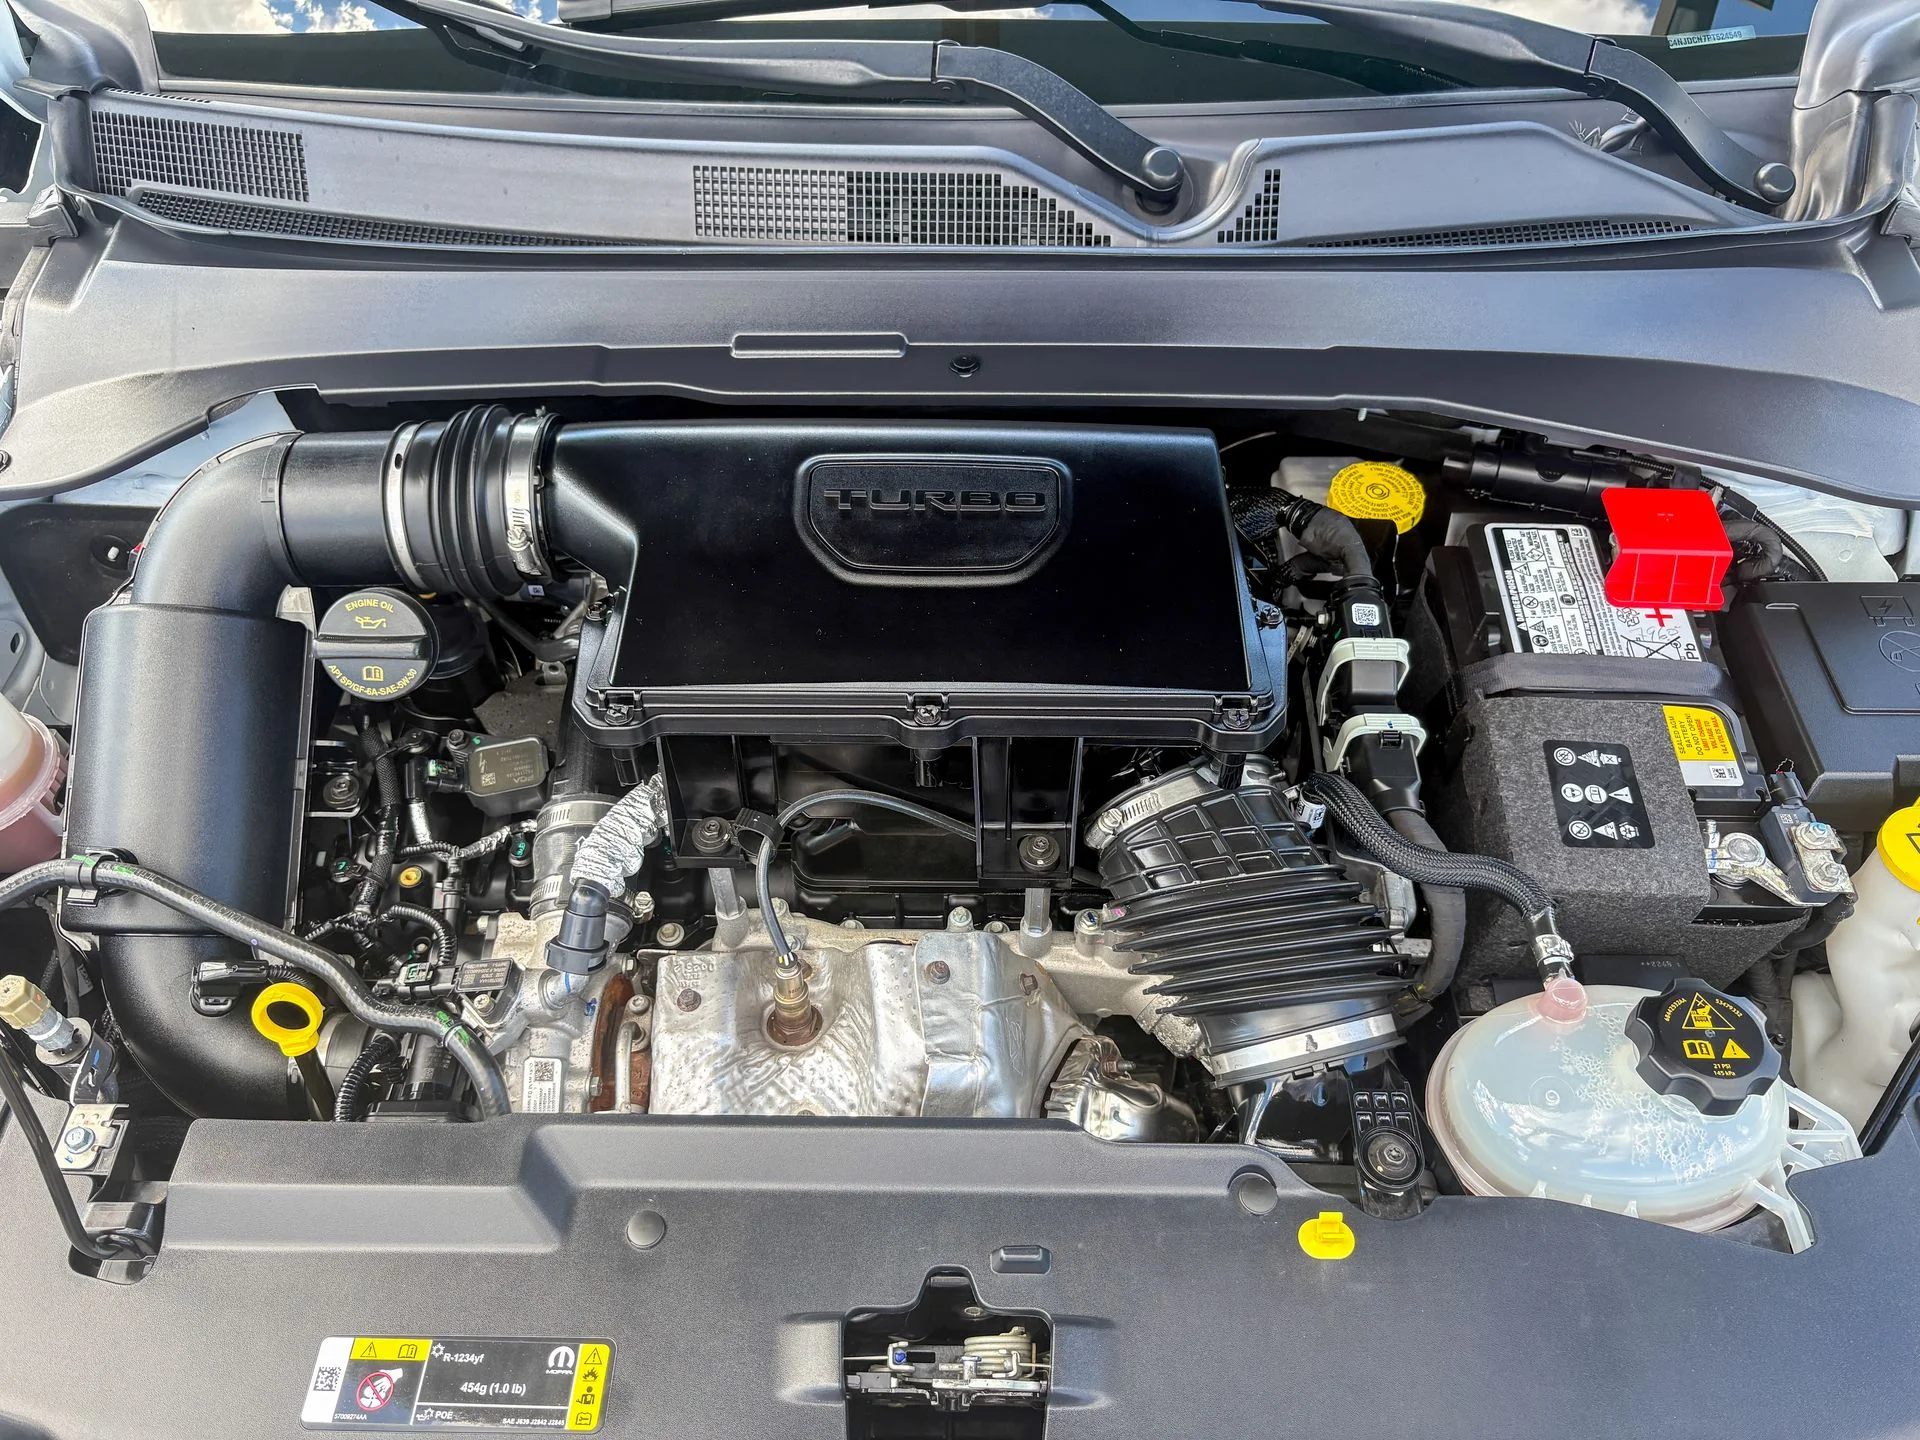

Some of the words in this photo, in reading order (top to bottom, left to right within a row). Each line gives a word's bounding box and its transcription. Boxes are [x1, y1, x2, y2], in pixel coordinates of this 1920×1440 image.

[823, 489, 1046, 512] TURBO
[1504, 570, 1524, 621] DANGER/POISON
[345, 599, 379, 612] ENGINE
[380, 601, 394, 613] OIL
[1684, 643, 1699, 660] Pb
[328, 664, 343, 679] API
[1679, 721, 1692, 748] BATTERY
[1692, 733, 1701, 746] NOT
[1696, 746, 1704, 755] DO
[443, 1353, 484, 1365] R-1234yf
[460, 1382, 488, 1396] 454g
[489, 1383, 510, 1396] (1.0
[511, 1383, 527, 1396] lb)
[435, 1411, 454, 1420] POE
